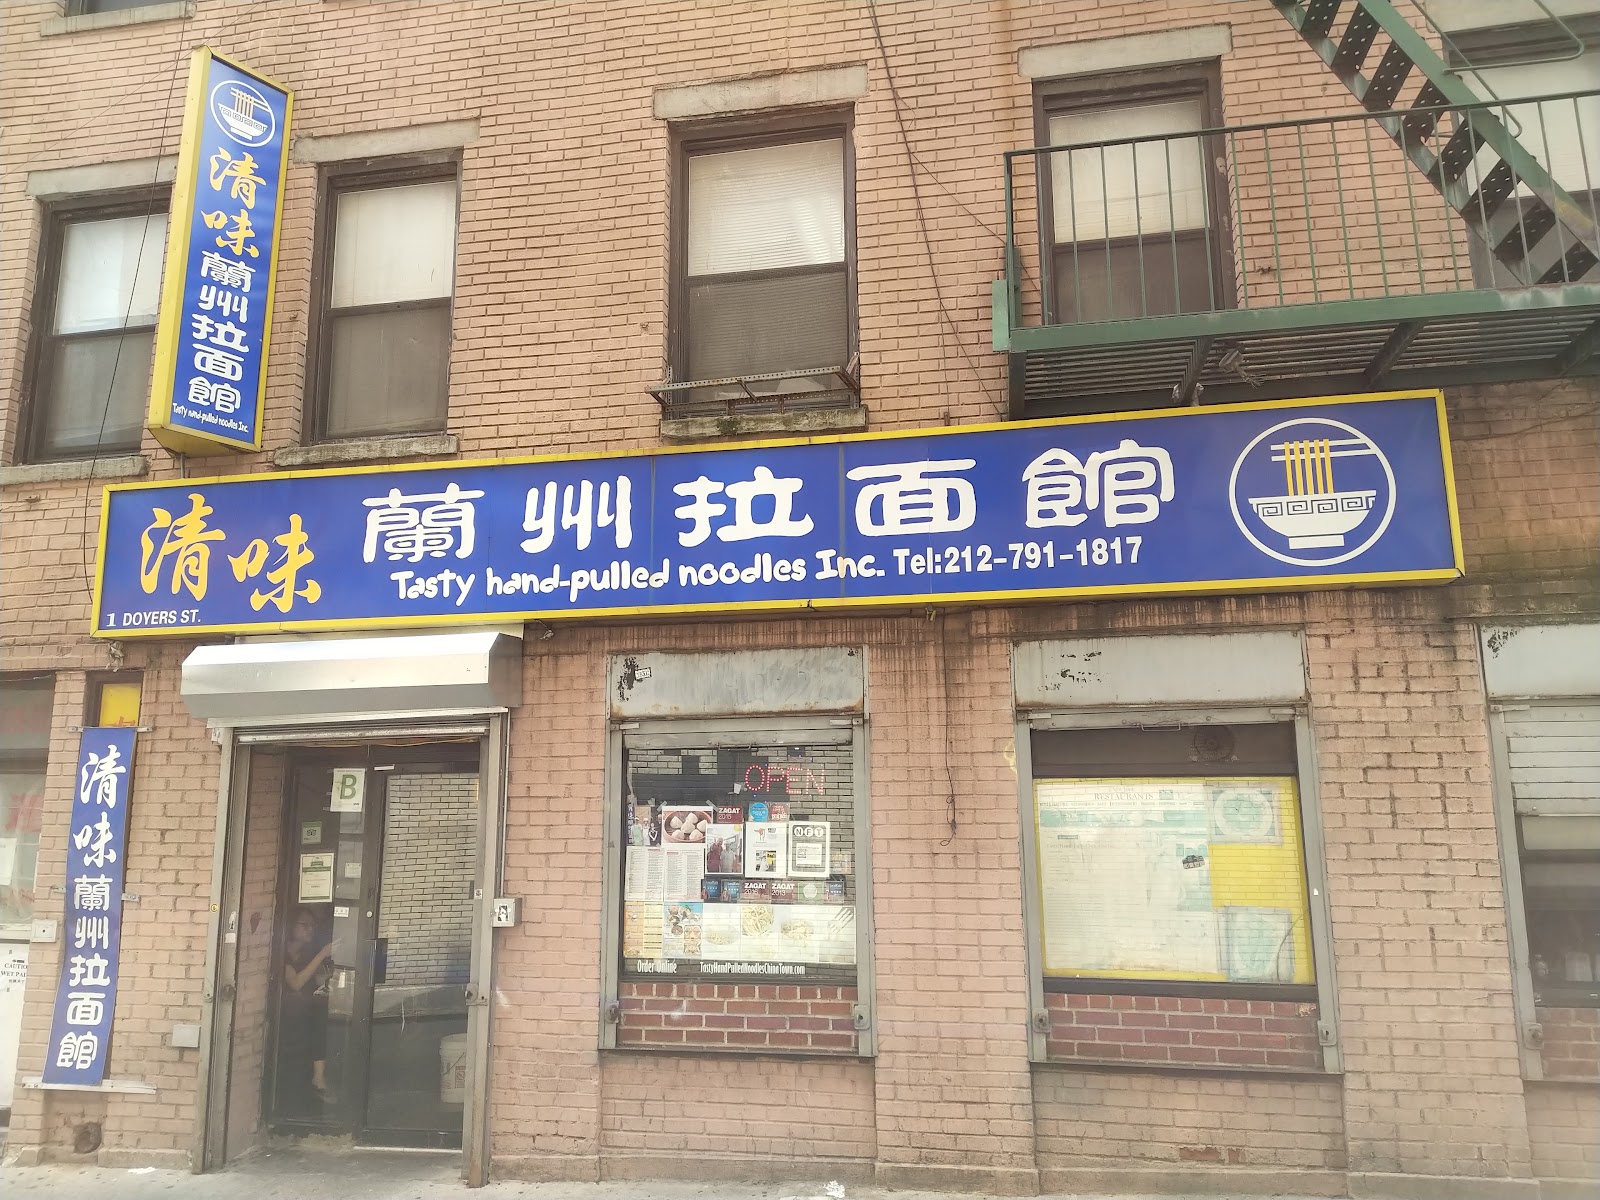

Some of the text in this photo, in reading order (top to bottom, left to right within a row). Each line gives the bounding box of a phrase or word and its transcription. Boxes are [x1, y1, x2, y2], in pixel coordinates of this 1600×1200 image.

[172, 402, 188, 418] Tasty
[218, 417, 238, 429] noodles
[391, 570, 474, 607] Tasty
[485, 559, 669, 603] hand-pulled
[679, 552, 807, 587] noodles
[815, 548, 886, 580] Inc.
[106, 608, 202, 627] 1 DOYERS ST.
[340, 774, 357, 800] B
[745, 765, 824, 795] OPEN
[637, 959, 655, 972] Order
